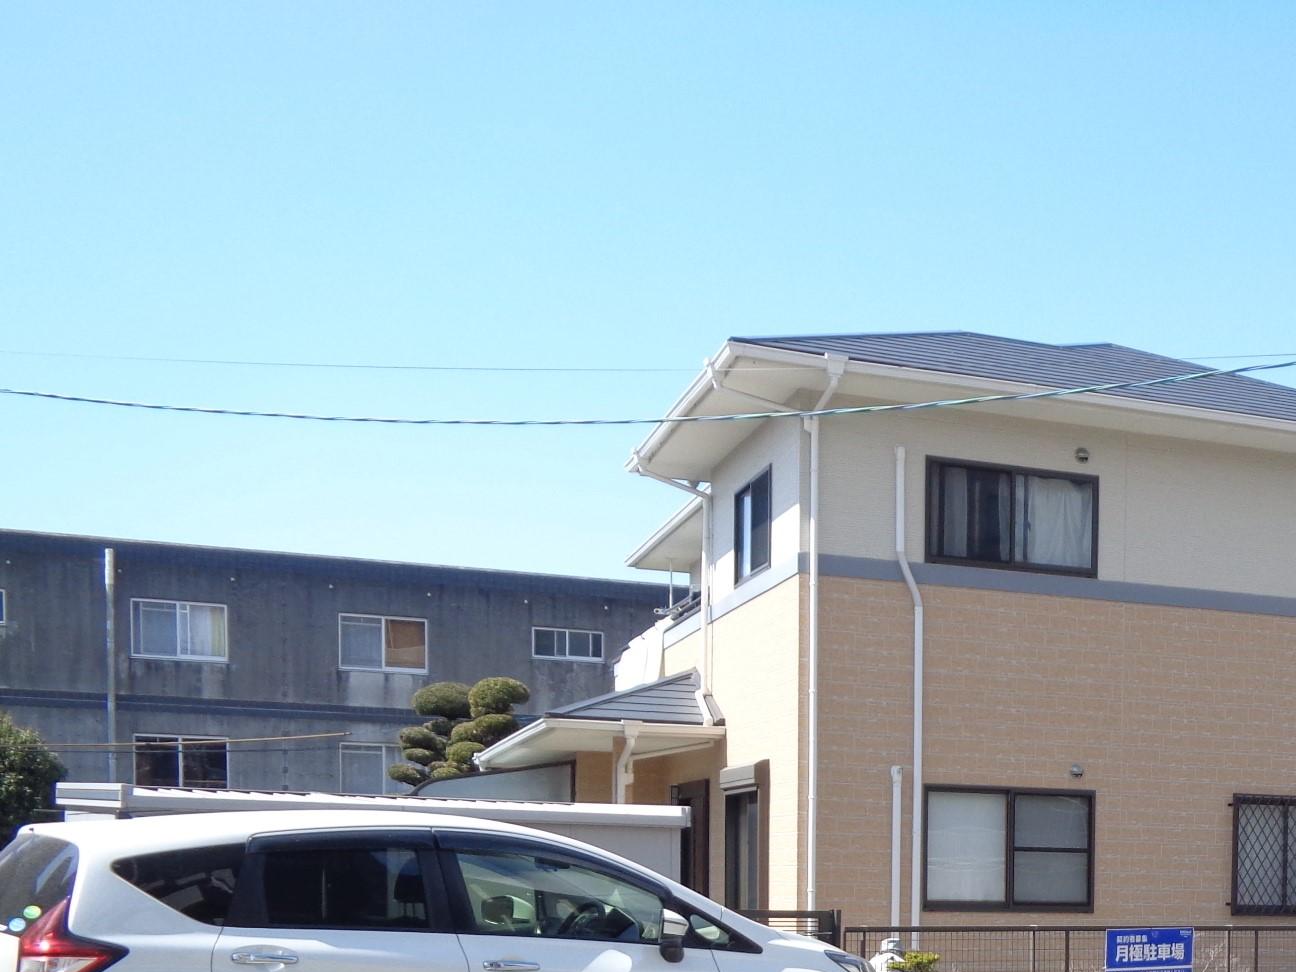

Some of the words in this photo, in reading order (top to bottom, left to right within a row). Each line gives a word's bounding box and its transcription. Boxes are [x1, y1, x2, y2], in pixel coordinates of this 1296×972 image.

[1115, 943, 1185, 962] 月極駐車場
